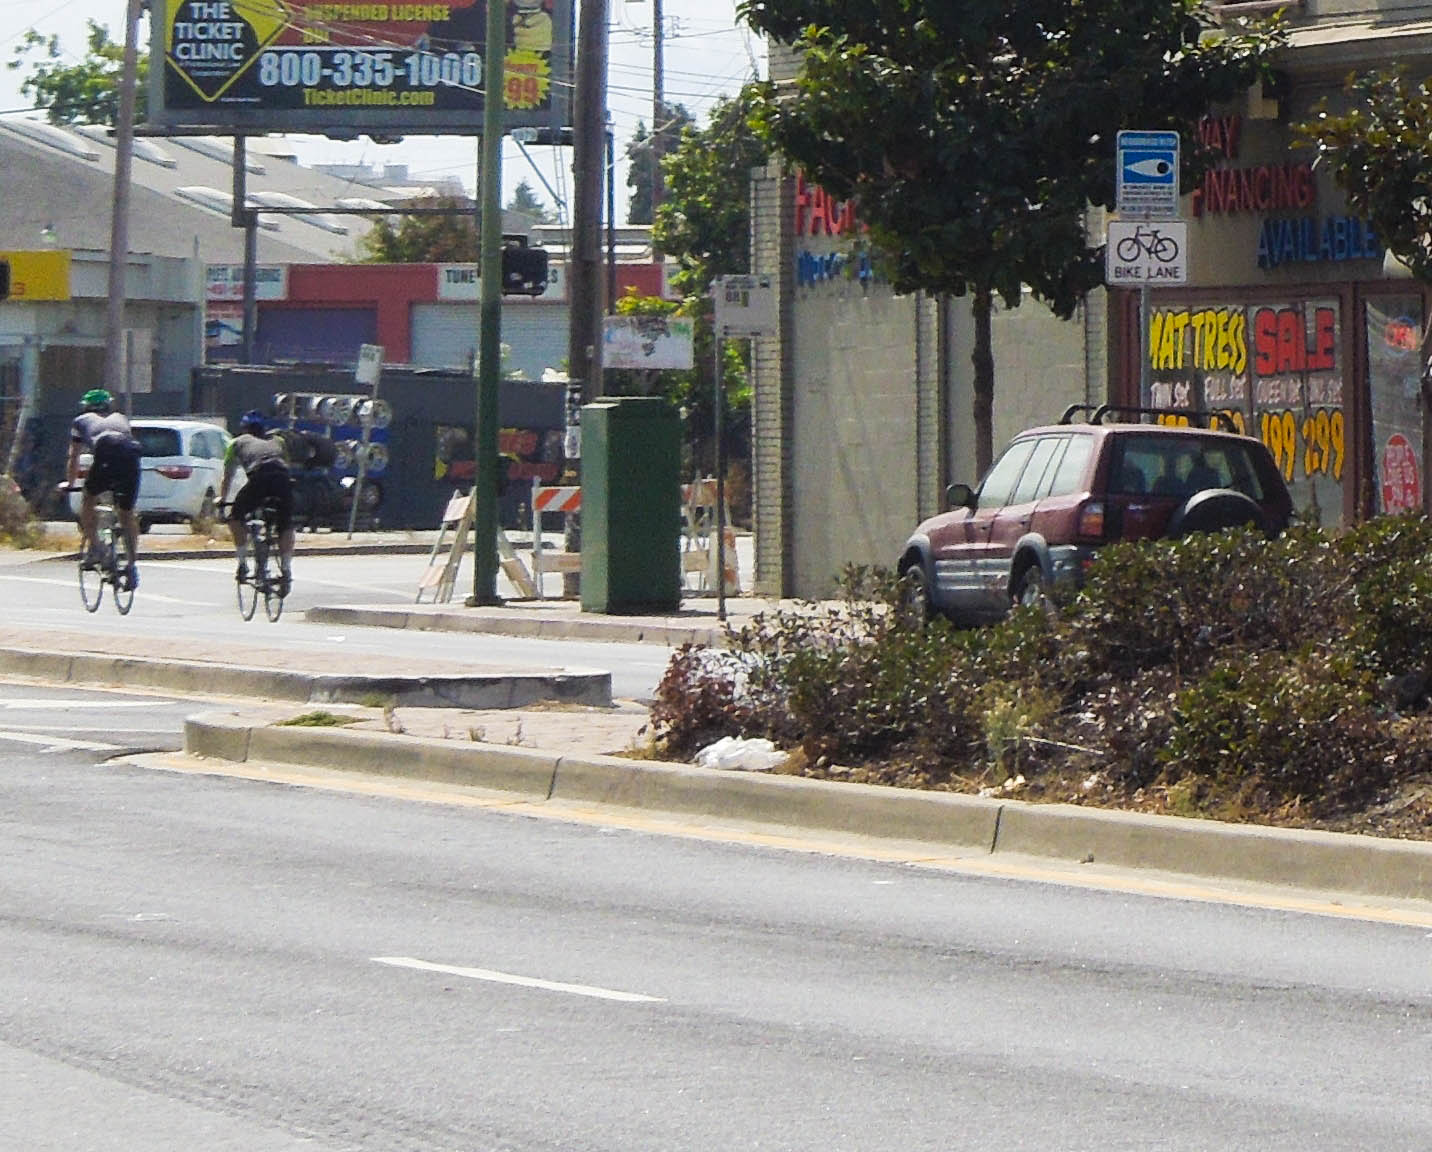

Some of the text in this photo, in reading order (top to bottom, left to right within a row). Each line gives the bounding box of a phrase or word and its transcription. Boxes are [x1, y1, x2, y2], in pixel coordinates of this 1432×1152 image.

[189, 2, 231, 19] THE
[391, 4, 451, 21] LICENSE
[175, 22, 245, 40] TICKET
[175, 42, 245, 60] CLINIC
[259, 52, 482, 87] 800-335-1000
[303, 88, 435, 106] TicketClinic.com
[1114, 266, 1181, 279] BIKE LANE
[1254, 306, 1338, 377] SALE
